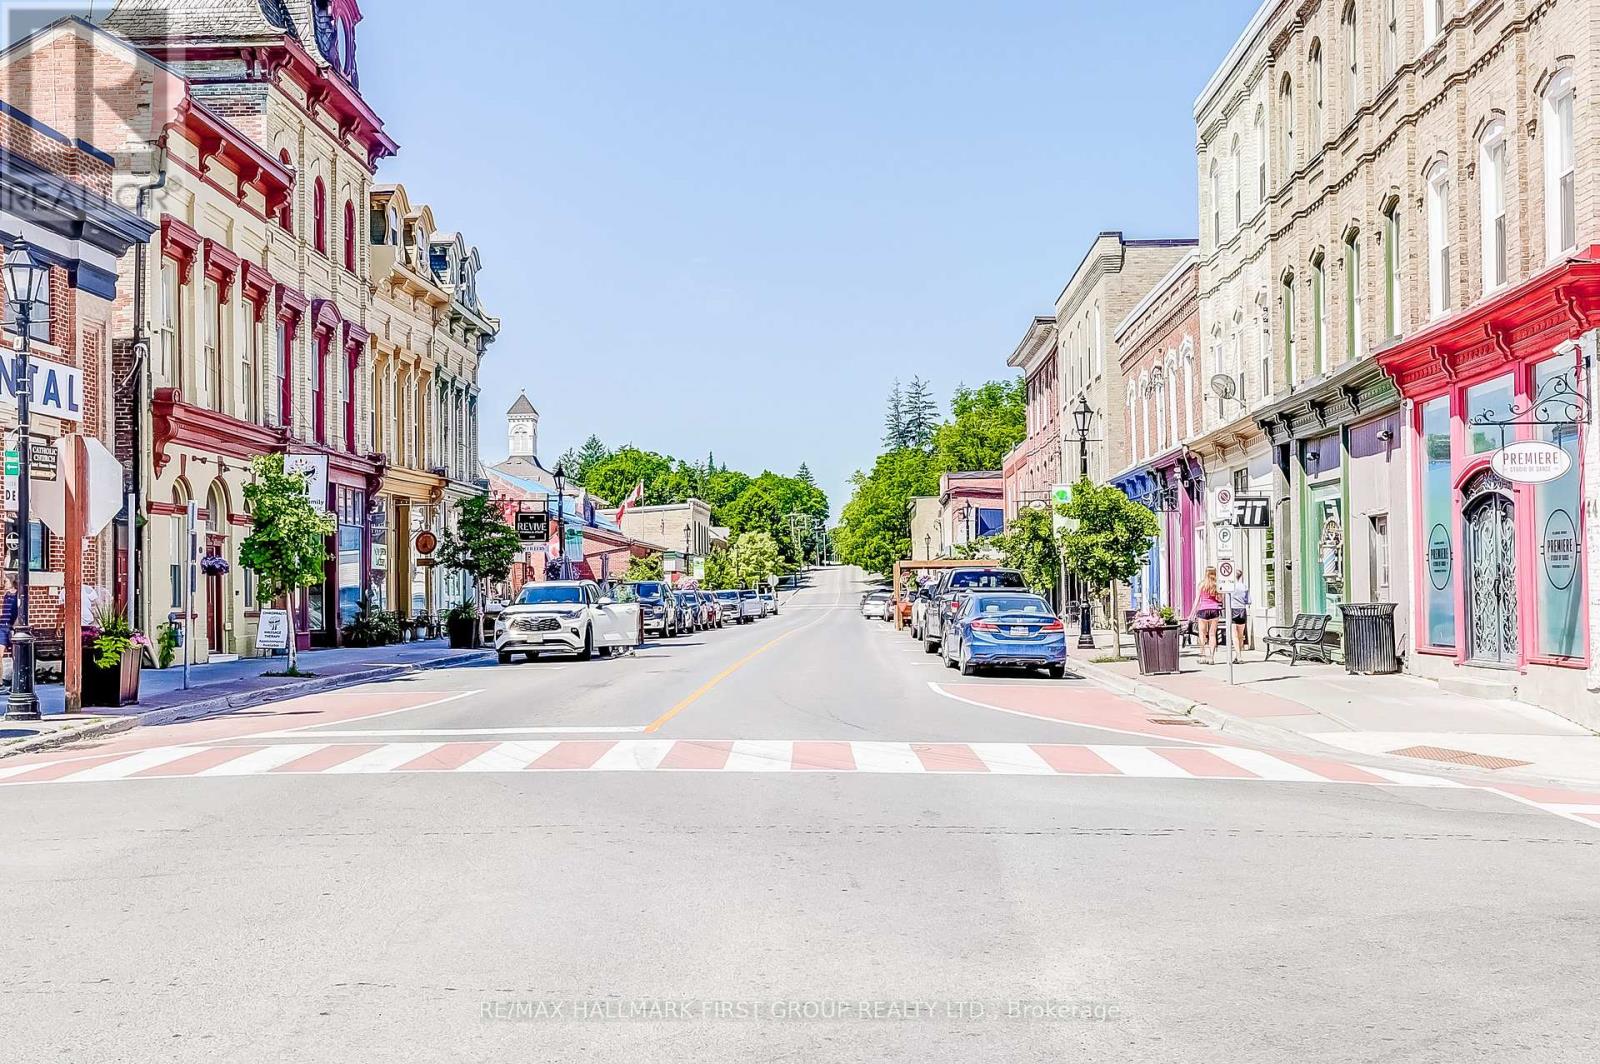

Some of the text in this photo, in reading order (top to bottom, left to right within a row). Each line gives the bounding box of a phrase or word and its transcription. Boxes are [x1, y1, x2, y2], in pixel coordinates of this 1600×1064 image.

[32, 446, 58, 456] CATHOLIC
[33, 454, 56, 463] CHURCH
[1503, 452, 1559, 465] PREMIERE
[517, 522, 547, 531] REVIVE
[1547, 538, 1573, 553] PREMIERE
